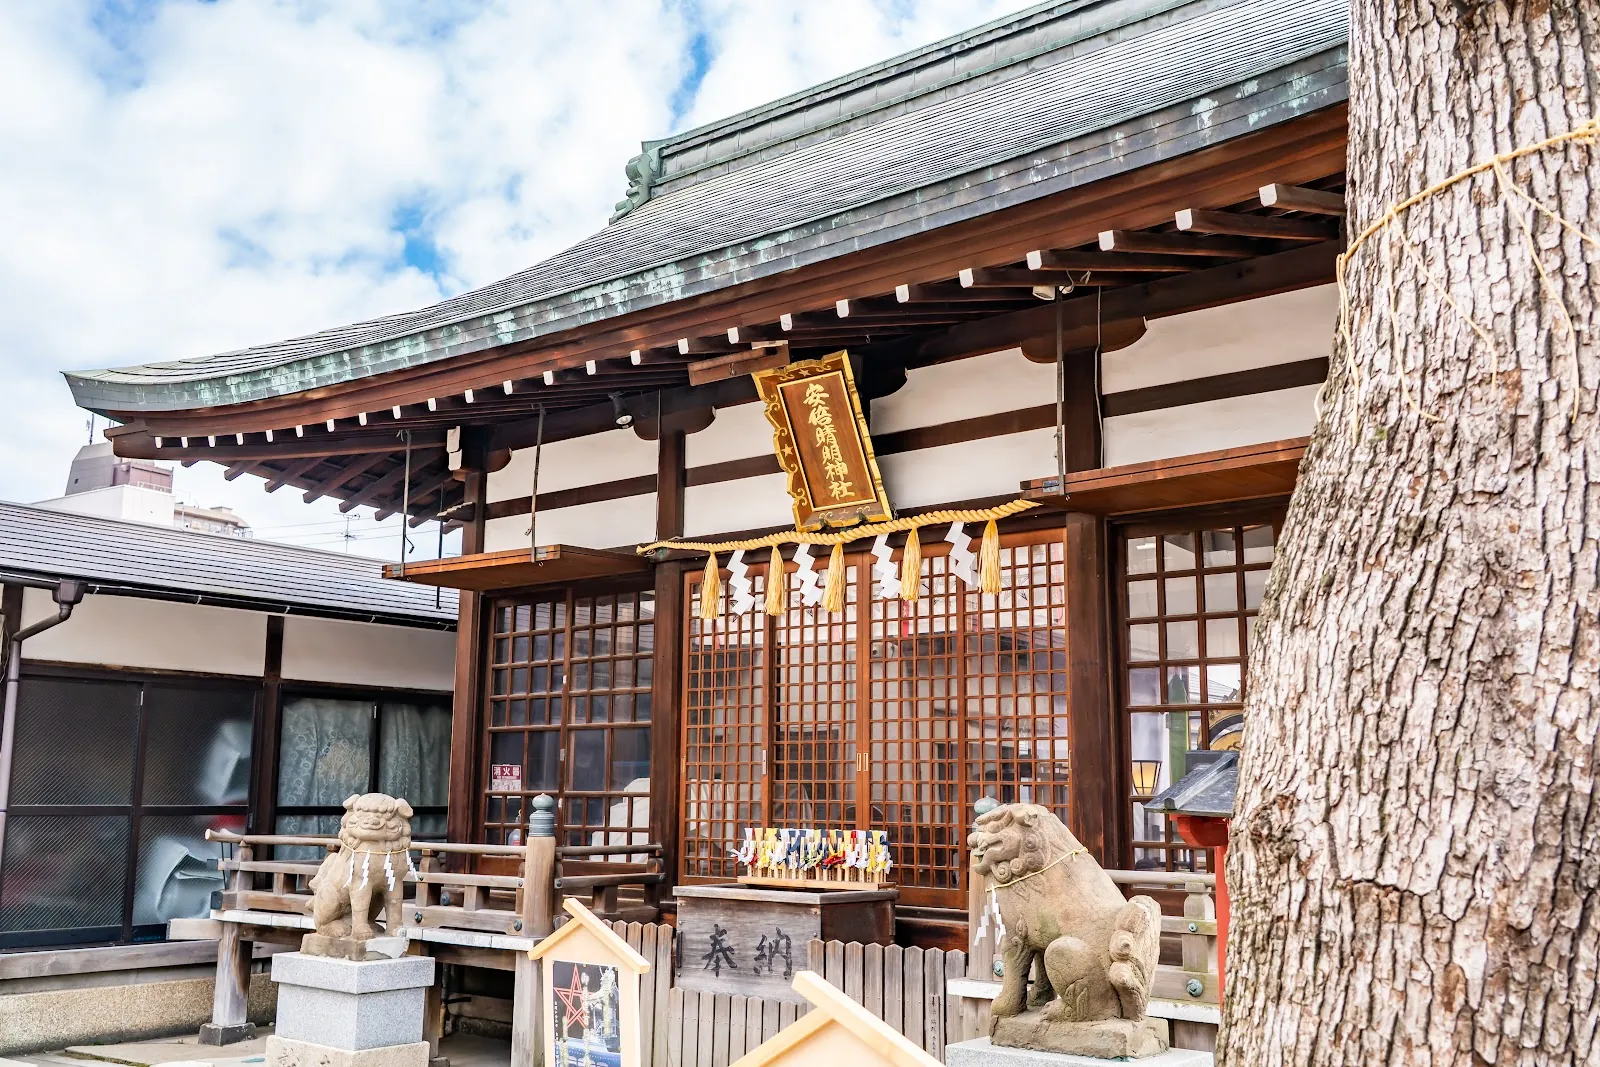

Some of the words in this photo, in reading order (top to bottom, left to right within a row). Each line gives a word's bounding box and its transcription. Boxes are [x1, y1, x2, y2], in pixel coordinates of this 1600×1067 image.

[803, 383, 856, 500] 安倍晴明神社
[493, 766, 520, 776] 消火器
[701, 923, 793, 980] 奉納
